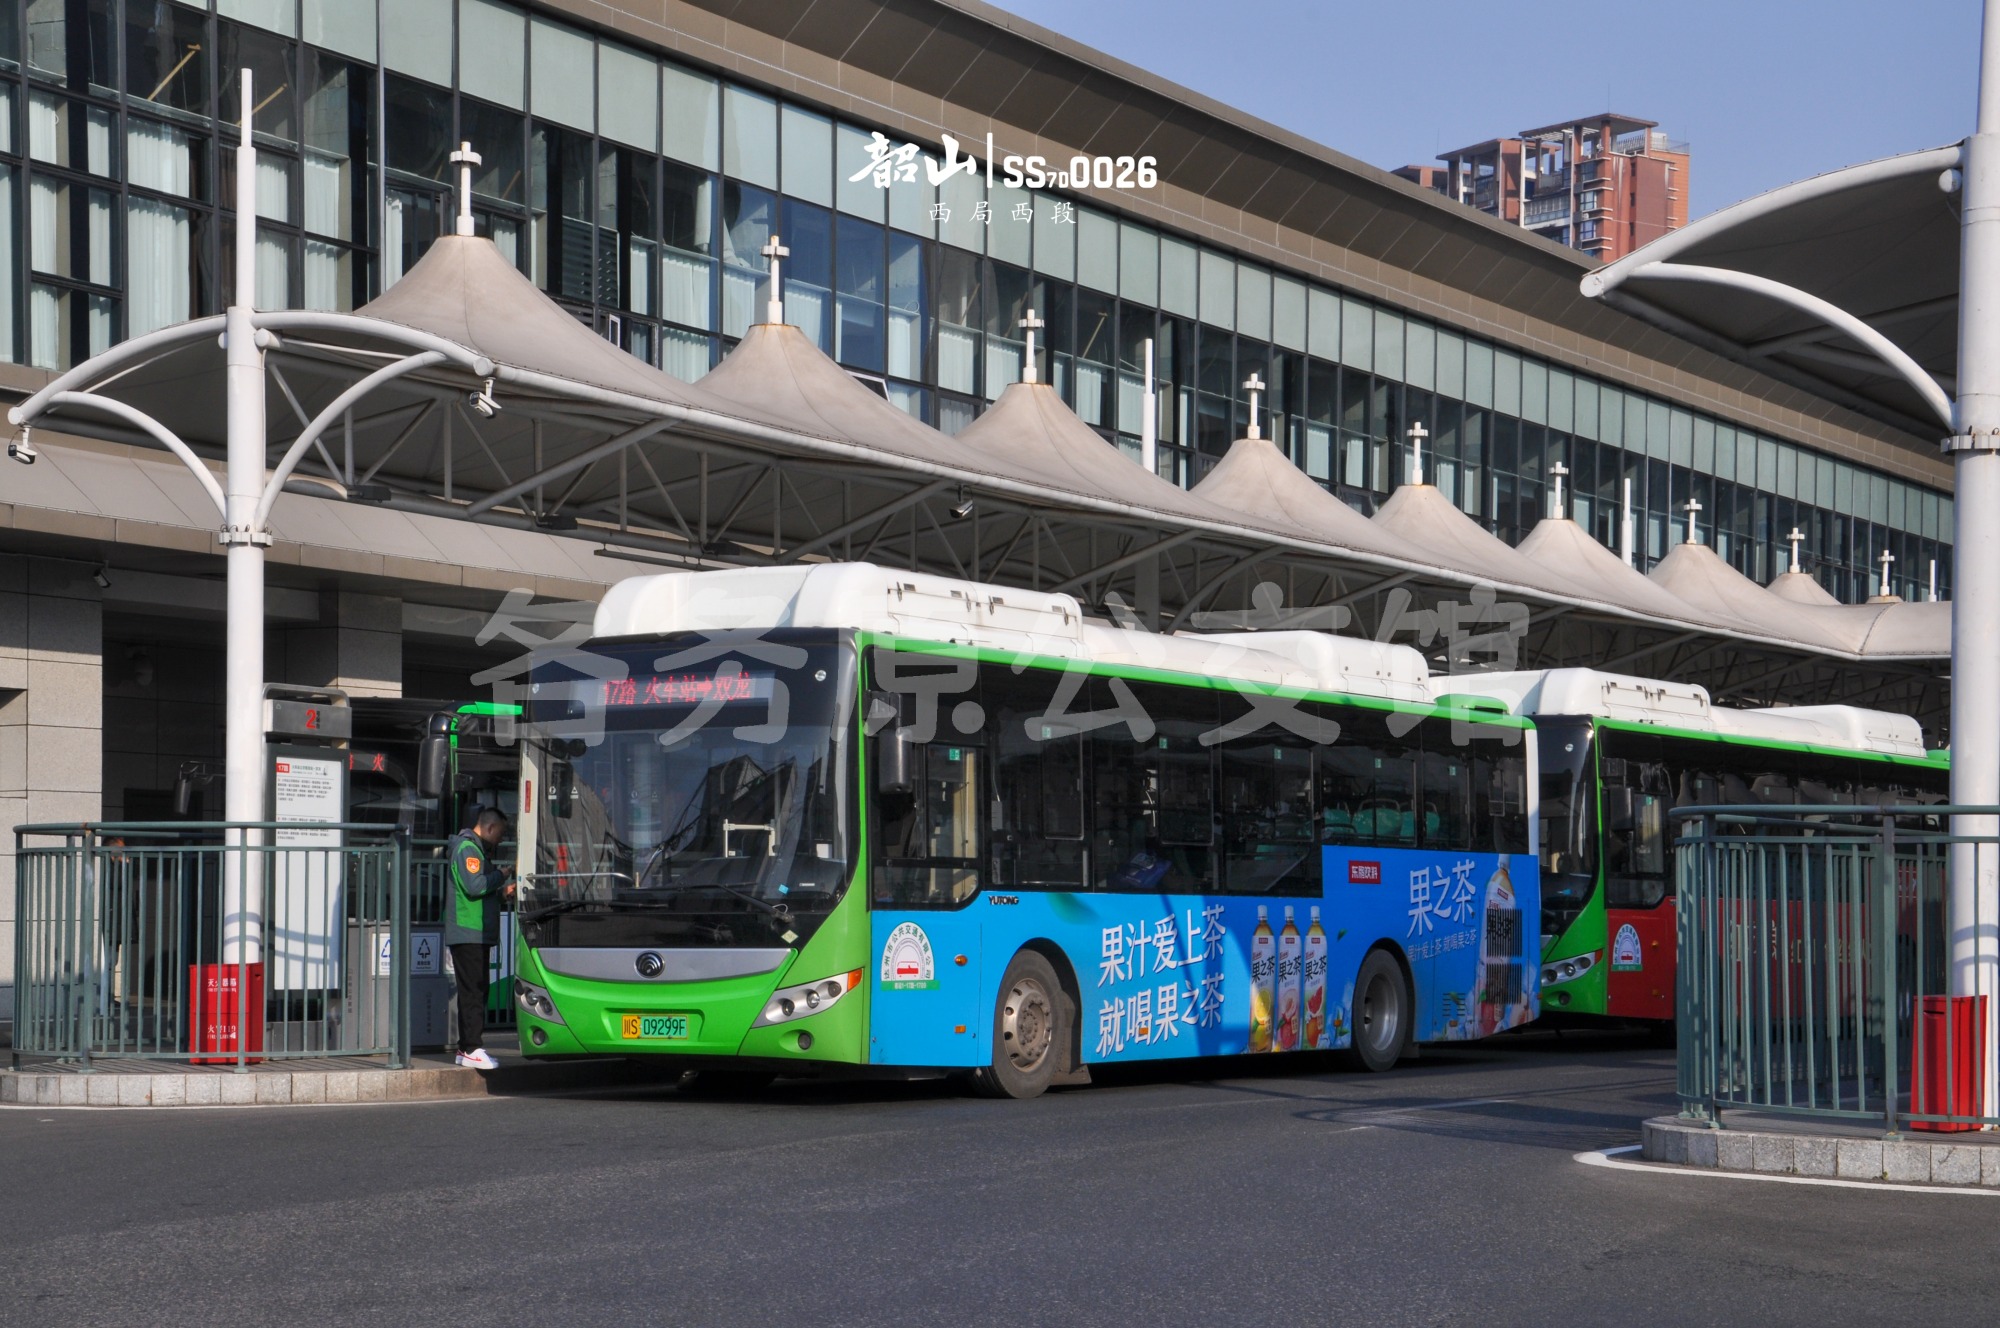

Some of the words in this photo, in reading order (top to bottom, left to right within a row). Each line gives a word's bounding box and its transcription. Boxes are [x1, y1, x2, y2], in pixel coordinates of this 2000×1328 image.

[604, 678, 637, 705] 17路
[305, 709, 317, 729] 2
[372, 752, 385, 771] 火
[988, 895, 1019, 905] YUTONG
[1407, 859, 1476, 938] 果之茶
[1098, 904, 1226, 988] 果汁爱上茶
[1252, 955, 1275, 984] 果之茶
[1278, 955, 1302, 984] 果之茶
[1305, 955, 1327, 984] 果之茶
[1096, 972, 1225, 1058] 就喝果之茶
